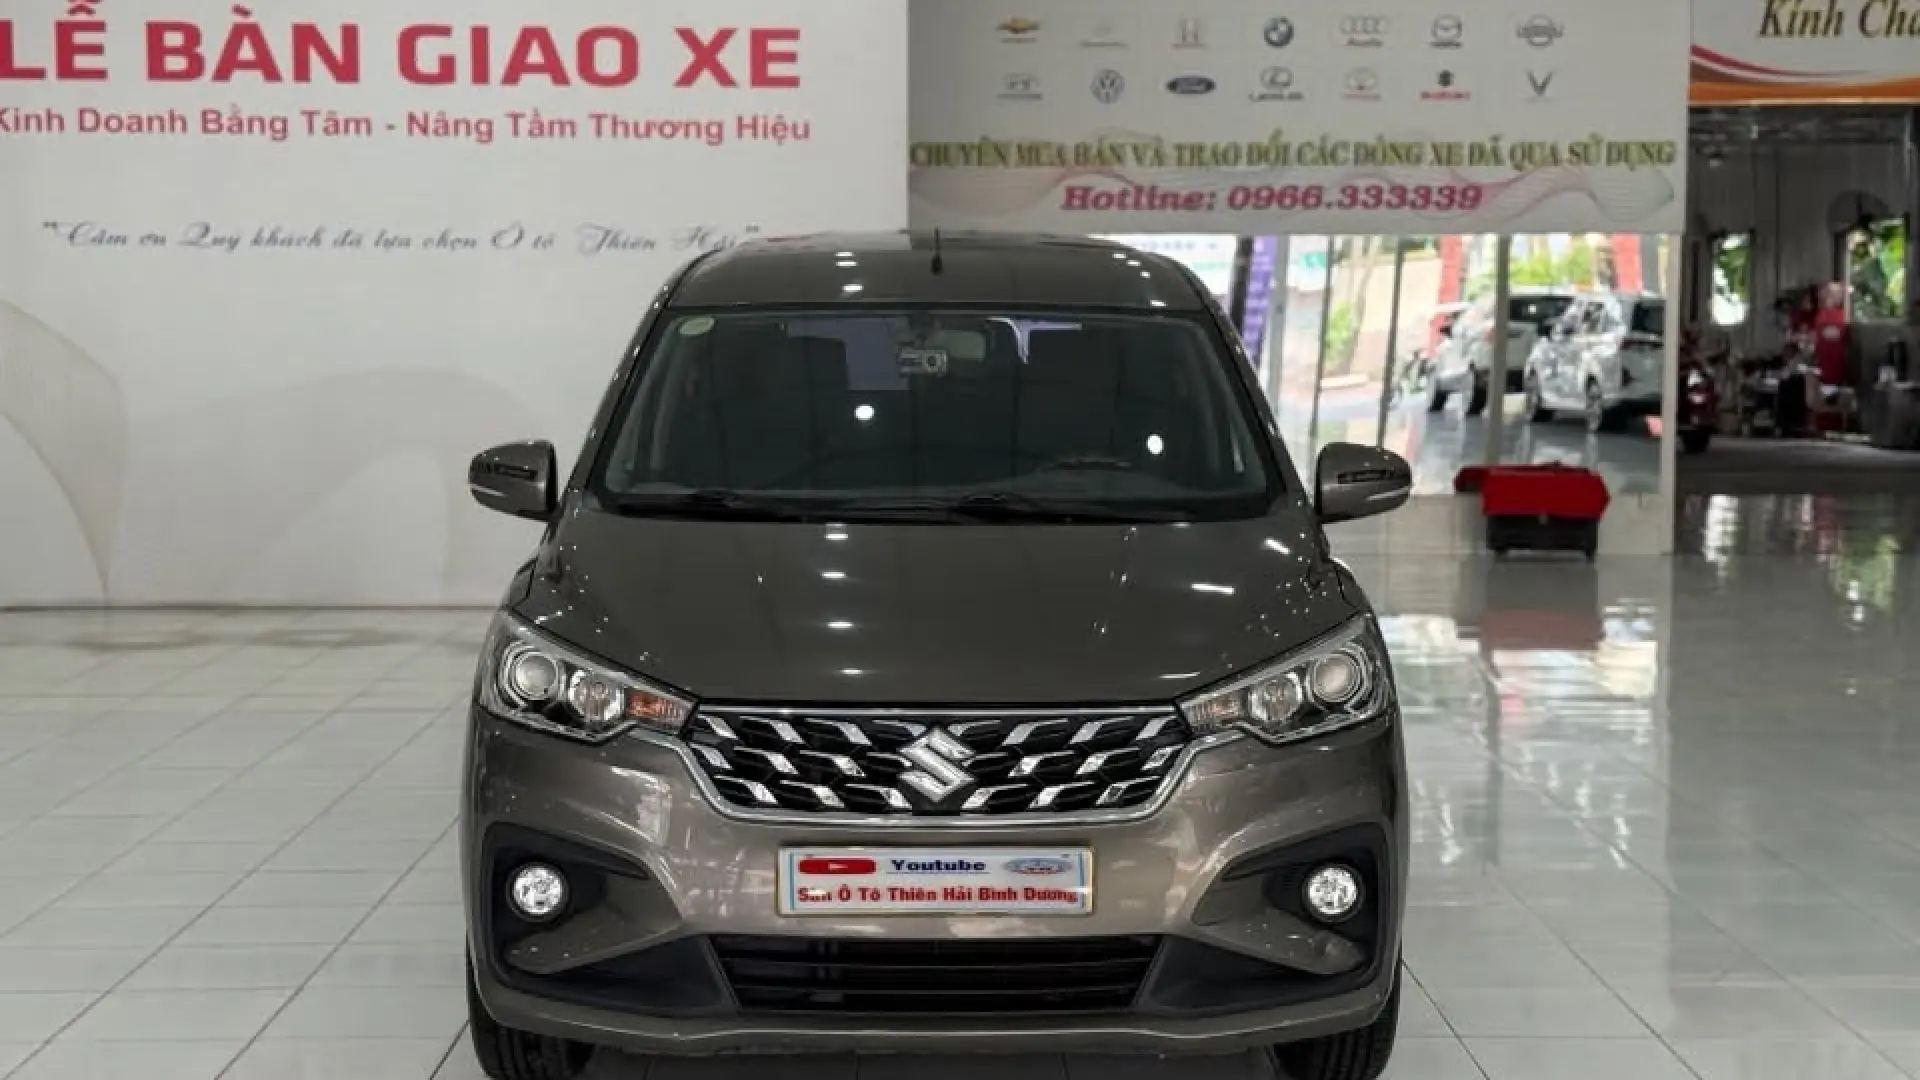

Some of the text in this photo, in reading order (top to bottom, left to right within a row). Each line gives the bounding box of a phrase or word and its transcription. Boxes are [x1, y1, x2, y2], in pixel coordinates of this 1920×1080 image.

[145, 4, 360, 83] BÀN
[397, 24, 640, 87] GIAO
[672, 27, 801, 88] XE
[78, 108, 188, 136] Doanh
[200, 103, 289, 141] Bằng
[300, 109, 373, 136] Tâm
[407, 110, 495, 143] Nâng
[505, 107, 577, 138] Tầm
[589, 112, 725, 146] Thương
[736, 113, 811, 146] Hiệu
[1014, 141, 1067, 167] MUA
[1174, 141, 1243, 167] TRAO
[1429, 141, 1465, 167] XE
[1509, 141, 1564, 172] QUA
[1060, 185, 1483, 211] Hotline: 0966.333339
[890, 858, 986, 872] Youtube
[857, 886, 881, 902] Tô
[886, 886, 938, 902] Thiên
